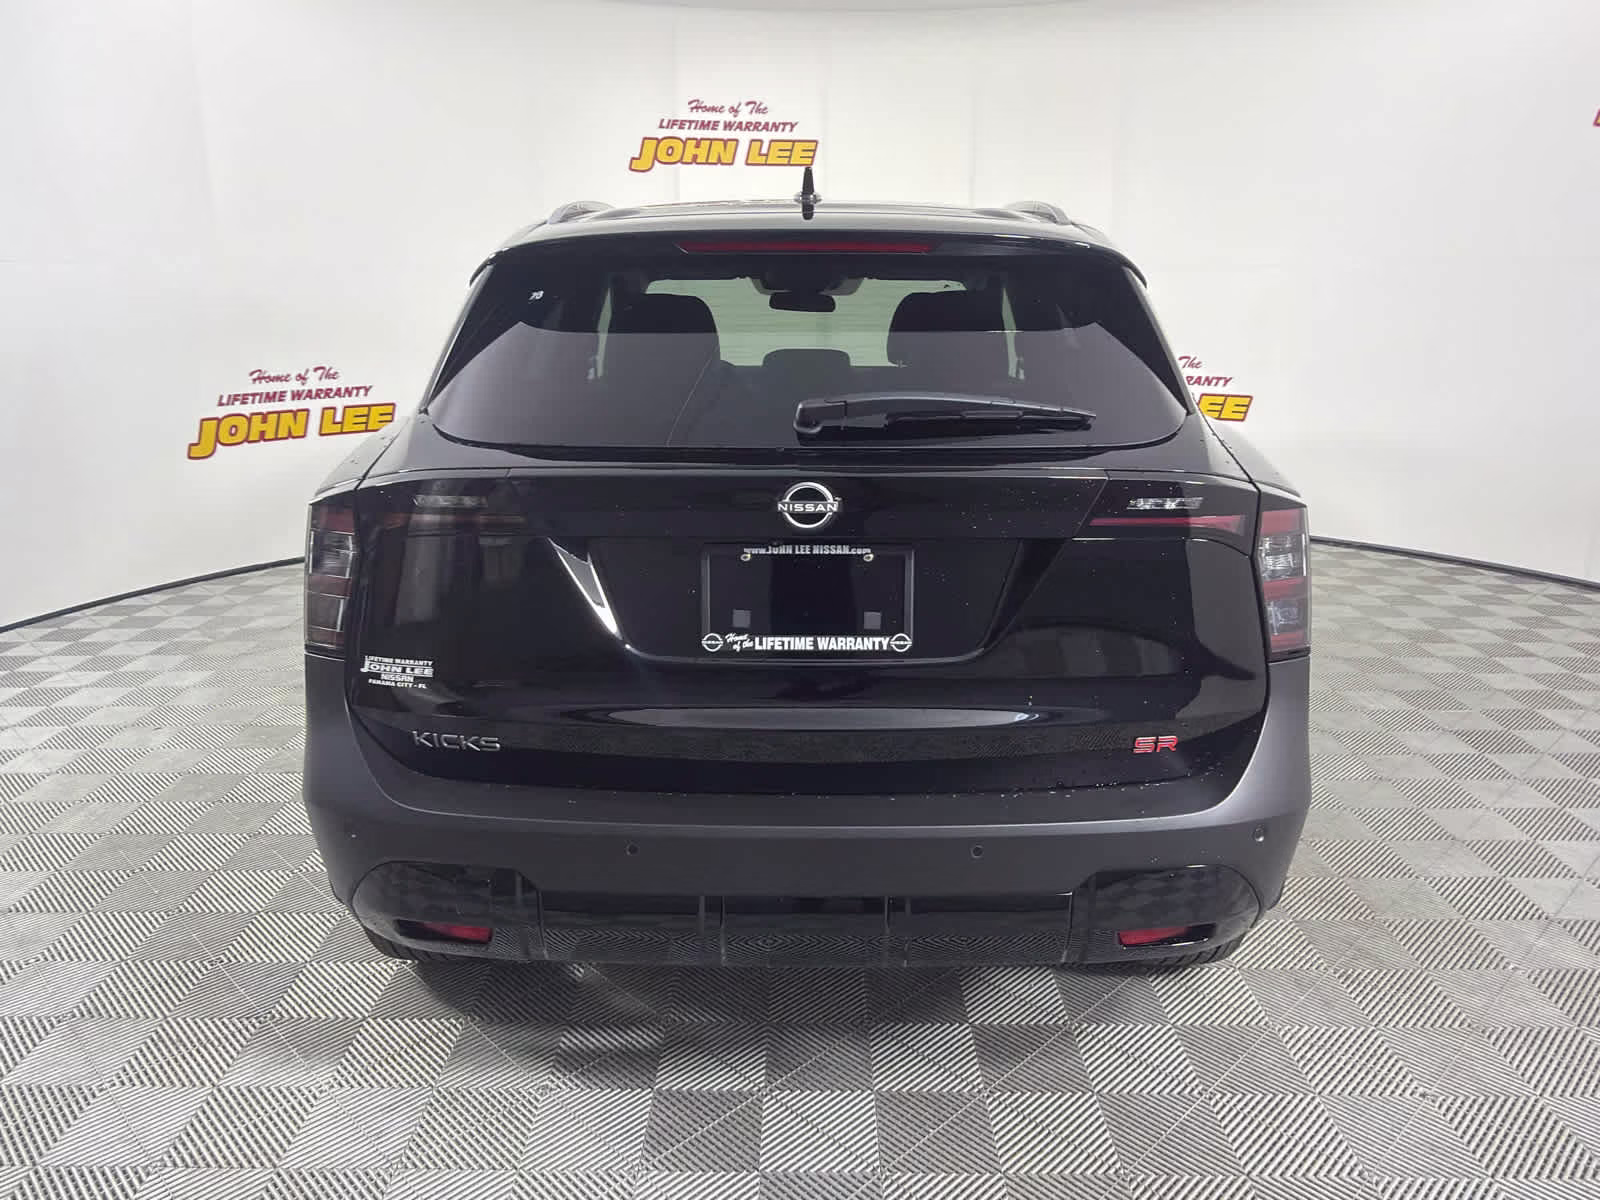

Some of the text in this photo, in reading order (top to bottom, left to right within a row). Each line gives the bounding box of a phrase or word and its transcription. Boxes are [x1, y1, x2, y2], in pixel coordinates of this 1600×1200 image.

[688, 99, 768, 117] Home of The
[658, 119, 798, 132] LIFETIME WARRANTY
[629, 136, 818, 172] JOHN LEE
[1178, 356, 1202, 368] The
[249, 366, 339, 385] Home of The
[1186, 376, 1232, 387] RANTY
[217, 385, 373, 407] LIFETIME WARRANTY
[1197, 393, 1253, 422] EE
[187, 402, 395, 460] JOHN LEE
[778, 502, 838, 512] NISSAN
[795, 545, 812, 554] LEE
[813, 545, 871, 554] NISSAN.com
[725, 632, 748, 643] Home
[755, 636, 890, 650] LIFETIME WARRANTY
[733, 640, 741, 652] of
[360, 660, 434, 676] JOHN LEE
[412, 731, 500, 751] KICKS
[1133, 736, 1178, 753] SR
